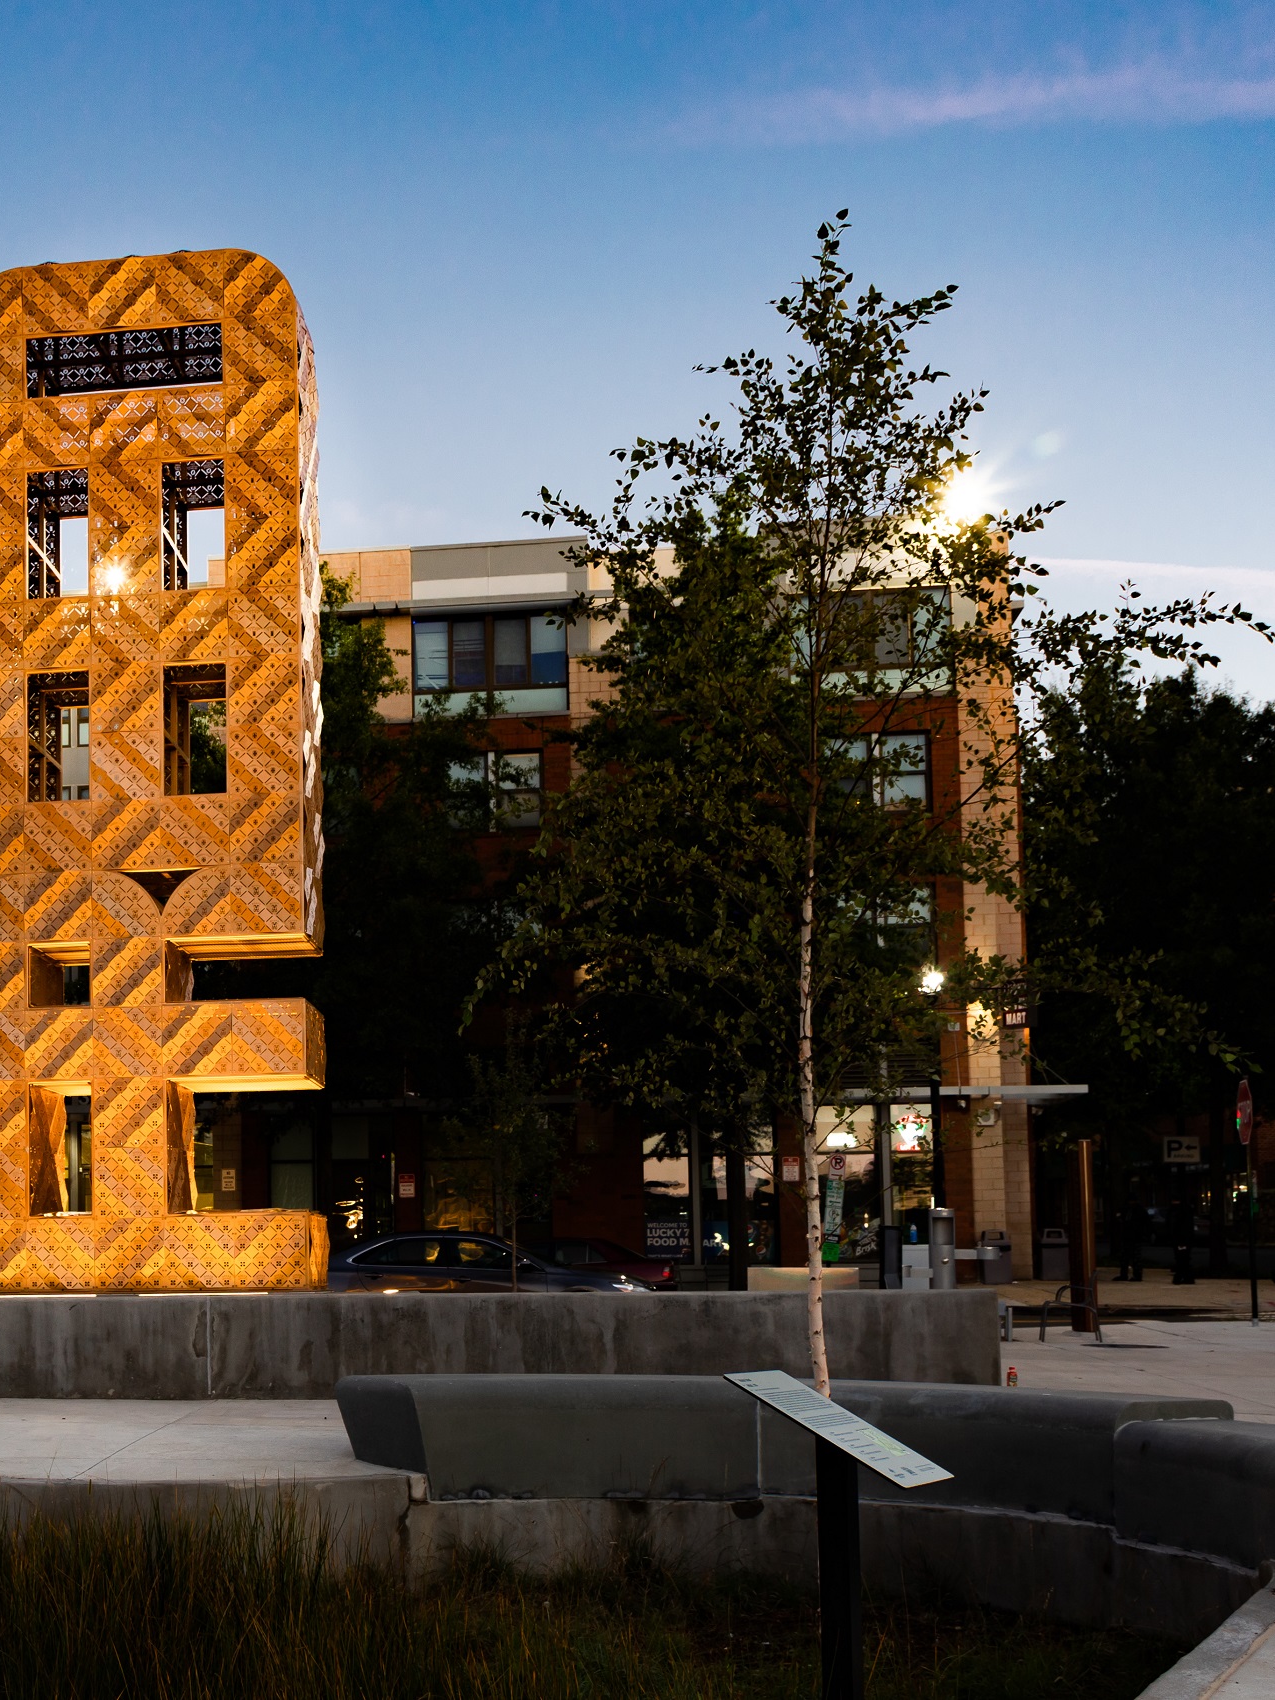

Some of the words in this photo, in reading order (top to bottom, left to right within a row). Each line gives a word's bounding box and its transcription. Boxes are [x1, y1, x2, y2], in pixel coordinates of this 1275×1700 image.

[1005, 1011, 1027, 1025] MART
[646, 1228, 682, 1237] LUCKY
[684, 1228, 690, 1237] 7
[646, 1237, 678, 1246] FOOD
